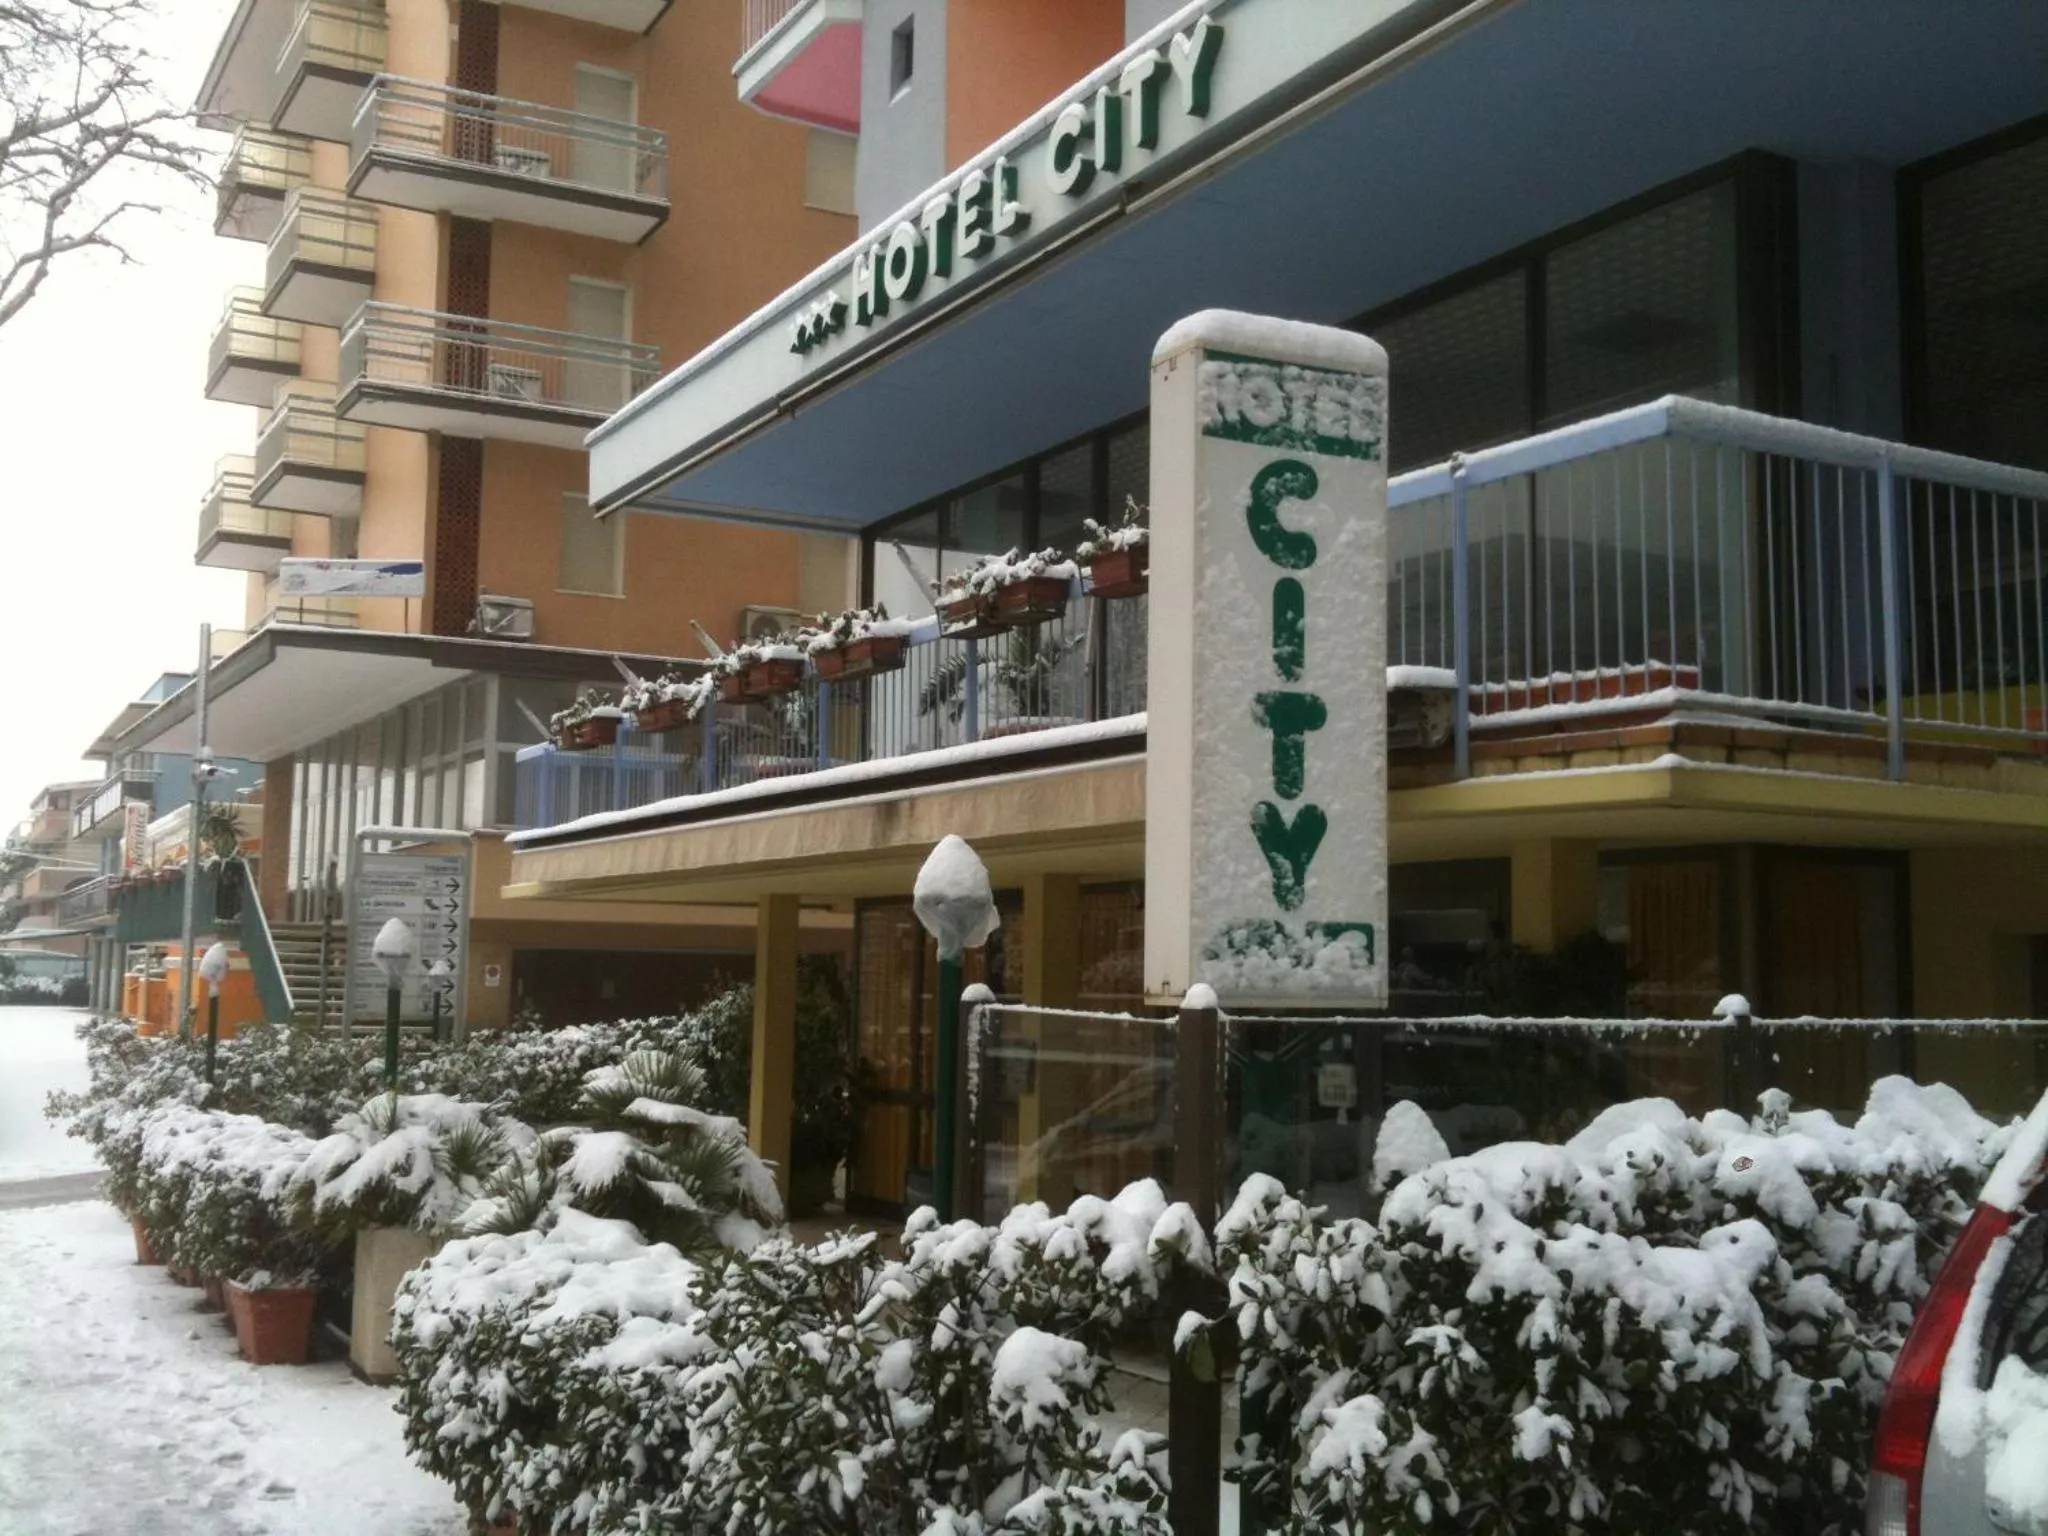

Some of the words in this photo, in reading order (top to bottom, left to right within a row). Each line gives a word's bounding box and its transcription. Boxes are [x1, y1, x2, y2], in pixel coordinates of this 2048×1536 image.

[852, 156, 1031, 326] HOTEL
[1047, 15, 1224, 196] CITY
[1246, 459, 1328, 912] CITY
